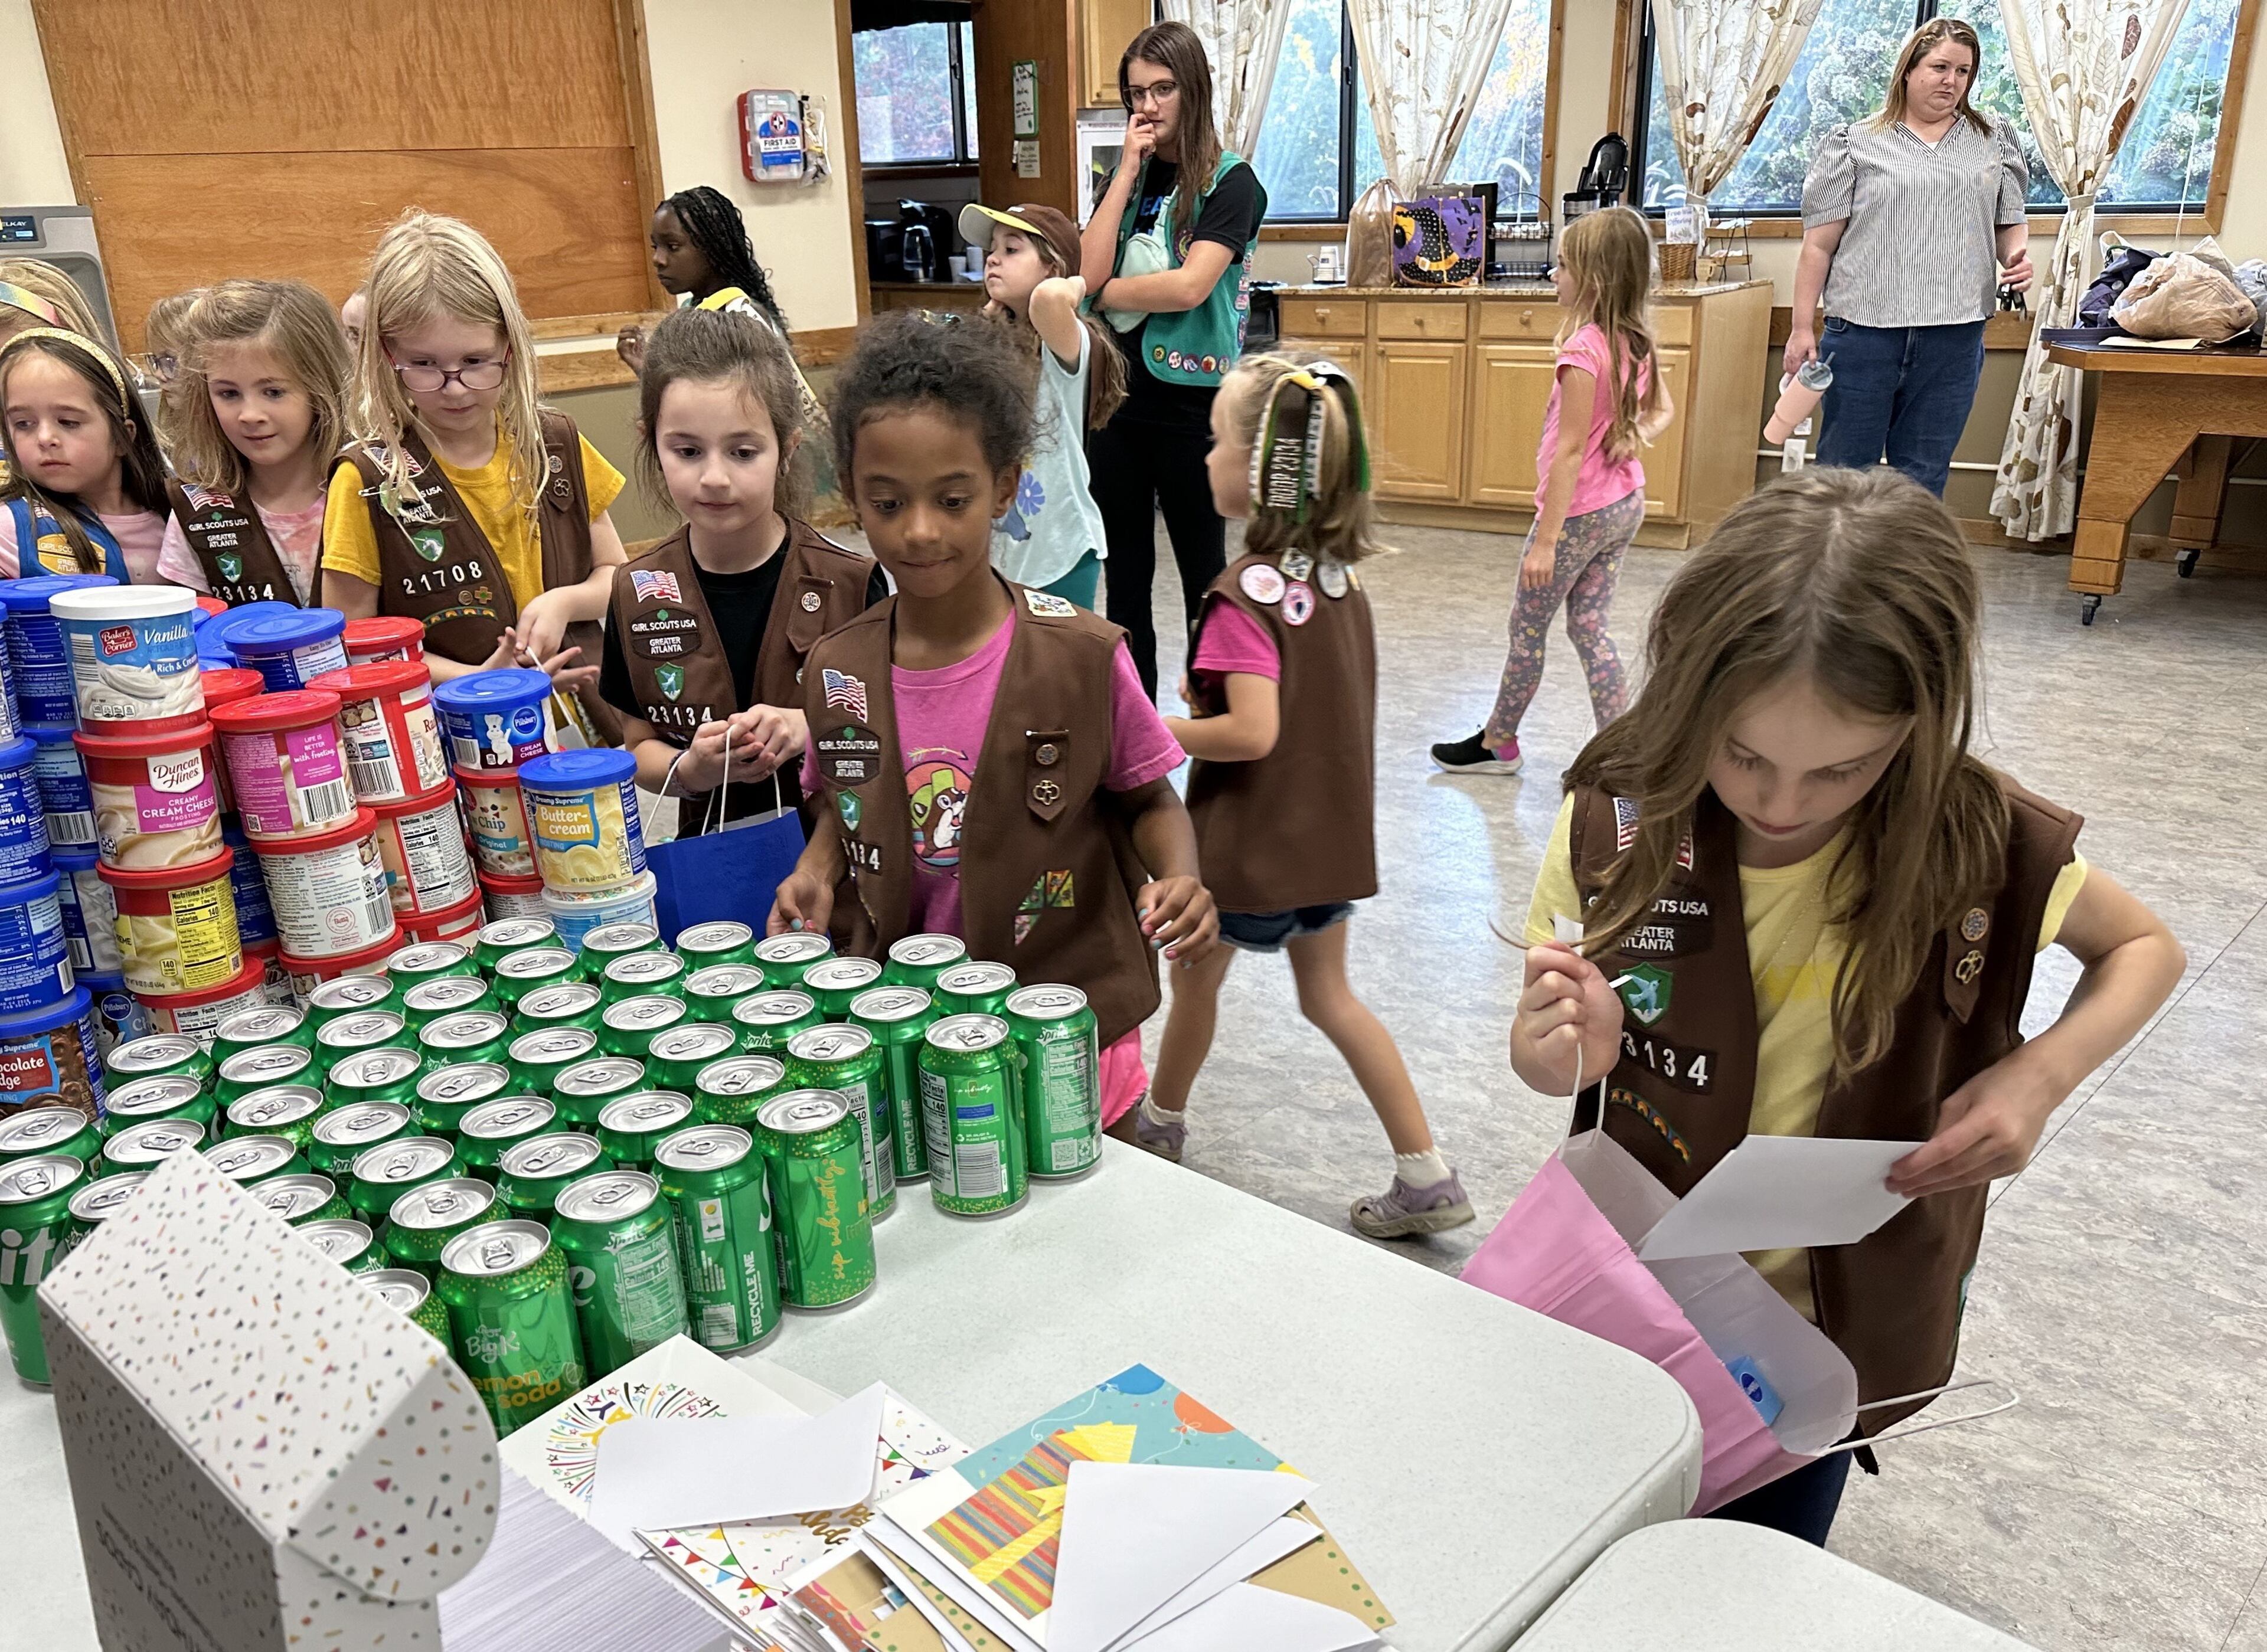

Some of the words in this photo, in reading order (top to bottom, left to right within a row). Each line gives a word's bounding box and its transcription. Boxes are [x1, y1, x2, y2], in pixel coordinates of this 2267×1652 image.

[189, 523, 205, 531] GIRL
[205, 521, 234, 529] SCOUTS
[234, 518, 249, 526] USA
[207, 533, 237, 542] GREATER
[209, 539, 238, 548] ATLANTA
[403, 561, 482, 594] 21708
[212, 584, 274, 601] 23134
[632, 623, 649, 632] GIRL
[649, 620, 680, 630] SCOUTS
[680, 619, 697, 628] USA
[144, 624, 188, 645] Vanilla
[104, 640, 135, 656] Corner
[649, 637, 681, 647] GREATER
[651, 645, 682, 655] ATLANTA
[156, 662, 175, 673] Rich
[176, 662, 182, 670] &
[182, 654, 198, 668] Cream
[514, 715, 537, 727] Pillsbury
[648, 706, 713, 726] 23134
[304, 741, 325, 750] BETTER
[520, 742, 542, 753] CREAM
[836, 741, 864, 750] SCOUTS
[865, 741, 879, 750] USA
[293, 753, 311, 763] with
[311, 748, 335, 760] frosting
[520, 748, 544, 758] CHEESE
[153, 756, 200, 778] Duncan
[163, 767, 200, 789] Hines
[168, 794, 198, 806] CREAMY
[555, 797, 584, 805] Supreme
[142, 806, 183, 818] CREAM
[185, 796, 214, 812] CHEESE
[11, 814, 27, 825] 140
[171, 812, 201, 822] FROSTING
[540, 806, 588, 822] Butter-
[478, 816, 506, 833] Chip
[549, 823, 592, 835] cream
[406, 840, 424, 849] Calories
[429, 834, 439, 843] 140
[478, 836, 507, 849] Original
[172, 888, 200, 900] Nutrition
[201, 885, 215, 894] Facts
[208, 906, 219, 917] 140
[1651, 899, 1678, 913] UTS
[1680, 901, 1709, 915] USA
[177, 915, 198, 924] Calories
[1634, 925, 1674, 940] EATER
[162, 960, 174, 969] 140
[103, 1003, 130, 1012] Pillsbury
[208, 1029, 217, 1038] 14
[4, 1041, 39, 1054] Supreme
[1076, 1056, 1087, 1069] 140
[1622, 1031, 1709, 1086] 3134
[901, 1099, 913, 1118] ME
[932, 1101, 945, 1112] 140
[903, 1118, 917, 1172] RECYCLE
[743, 1251, 756, 1275] ME
[746, 1274, 763, 1337] RECYCLE
[471, 1369, 541, 1392] emon
[498, 1378, 561, 1409] soda
